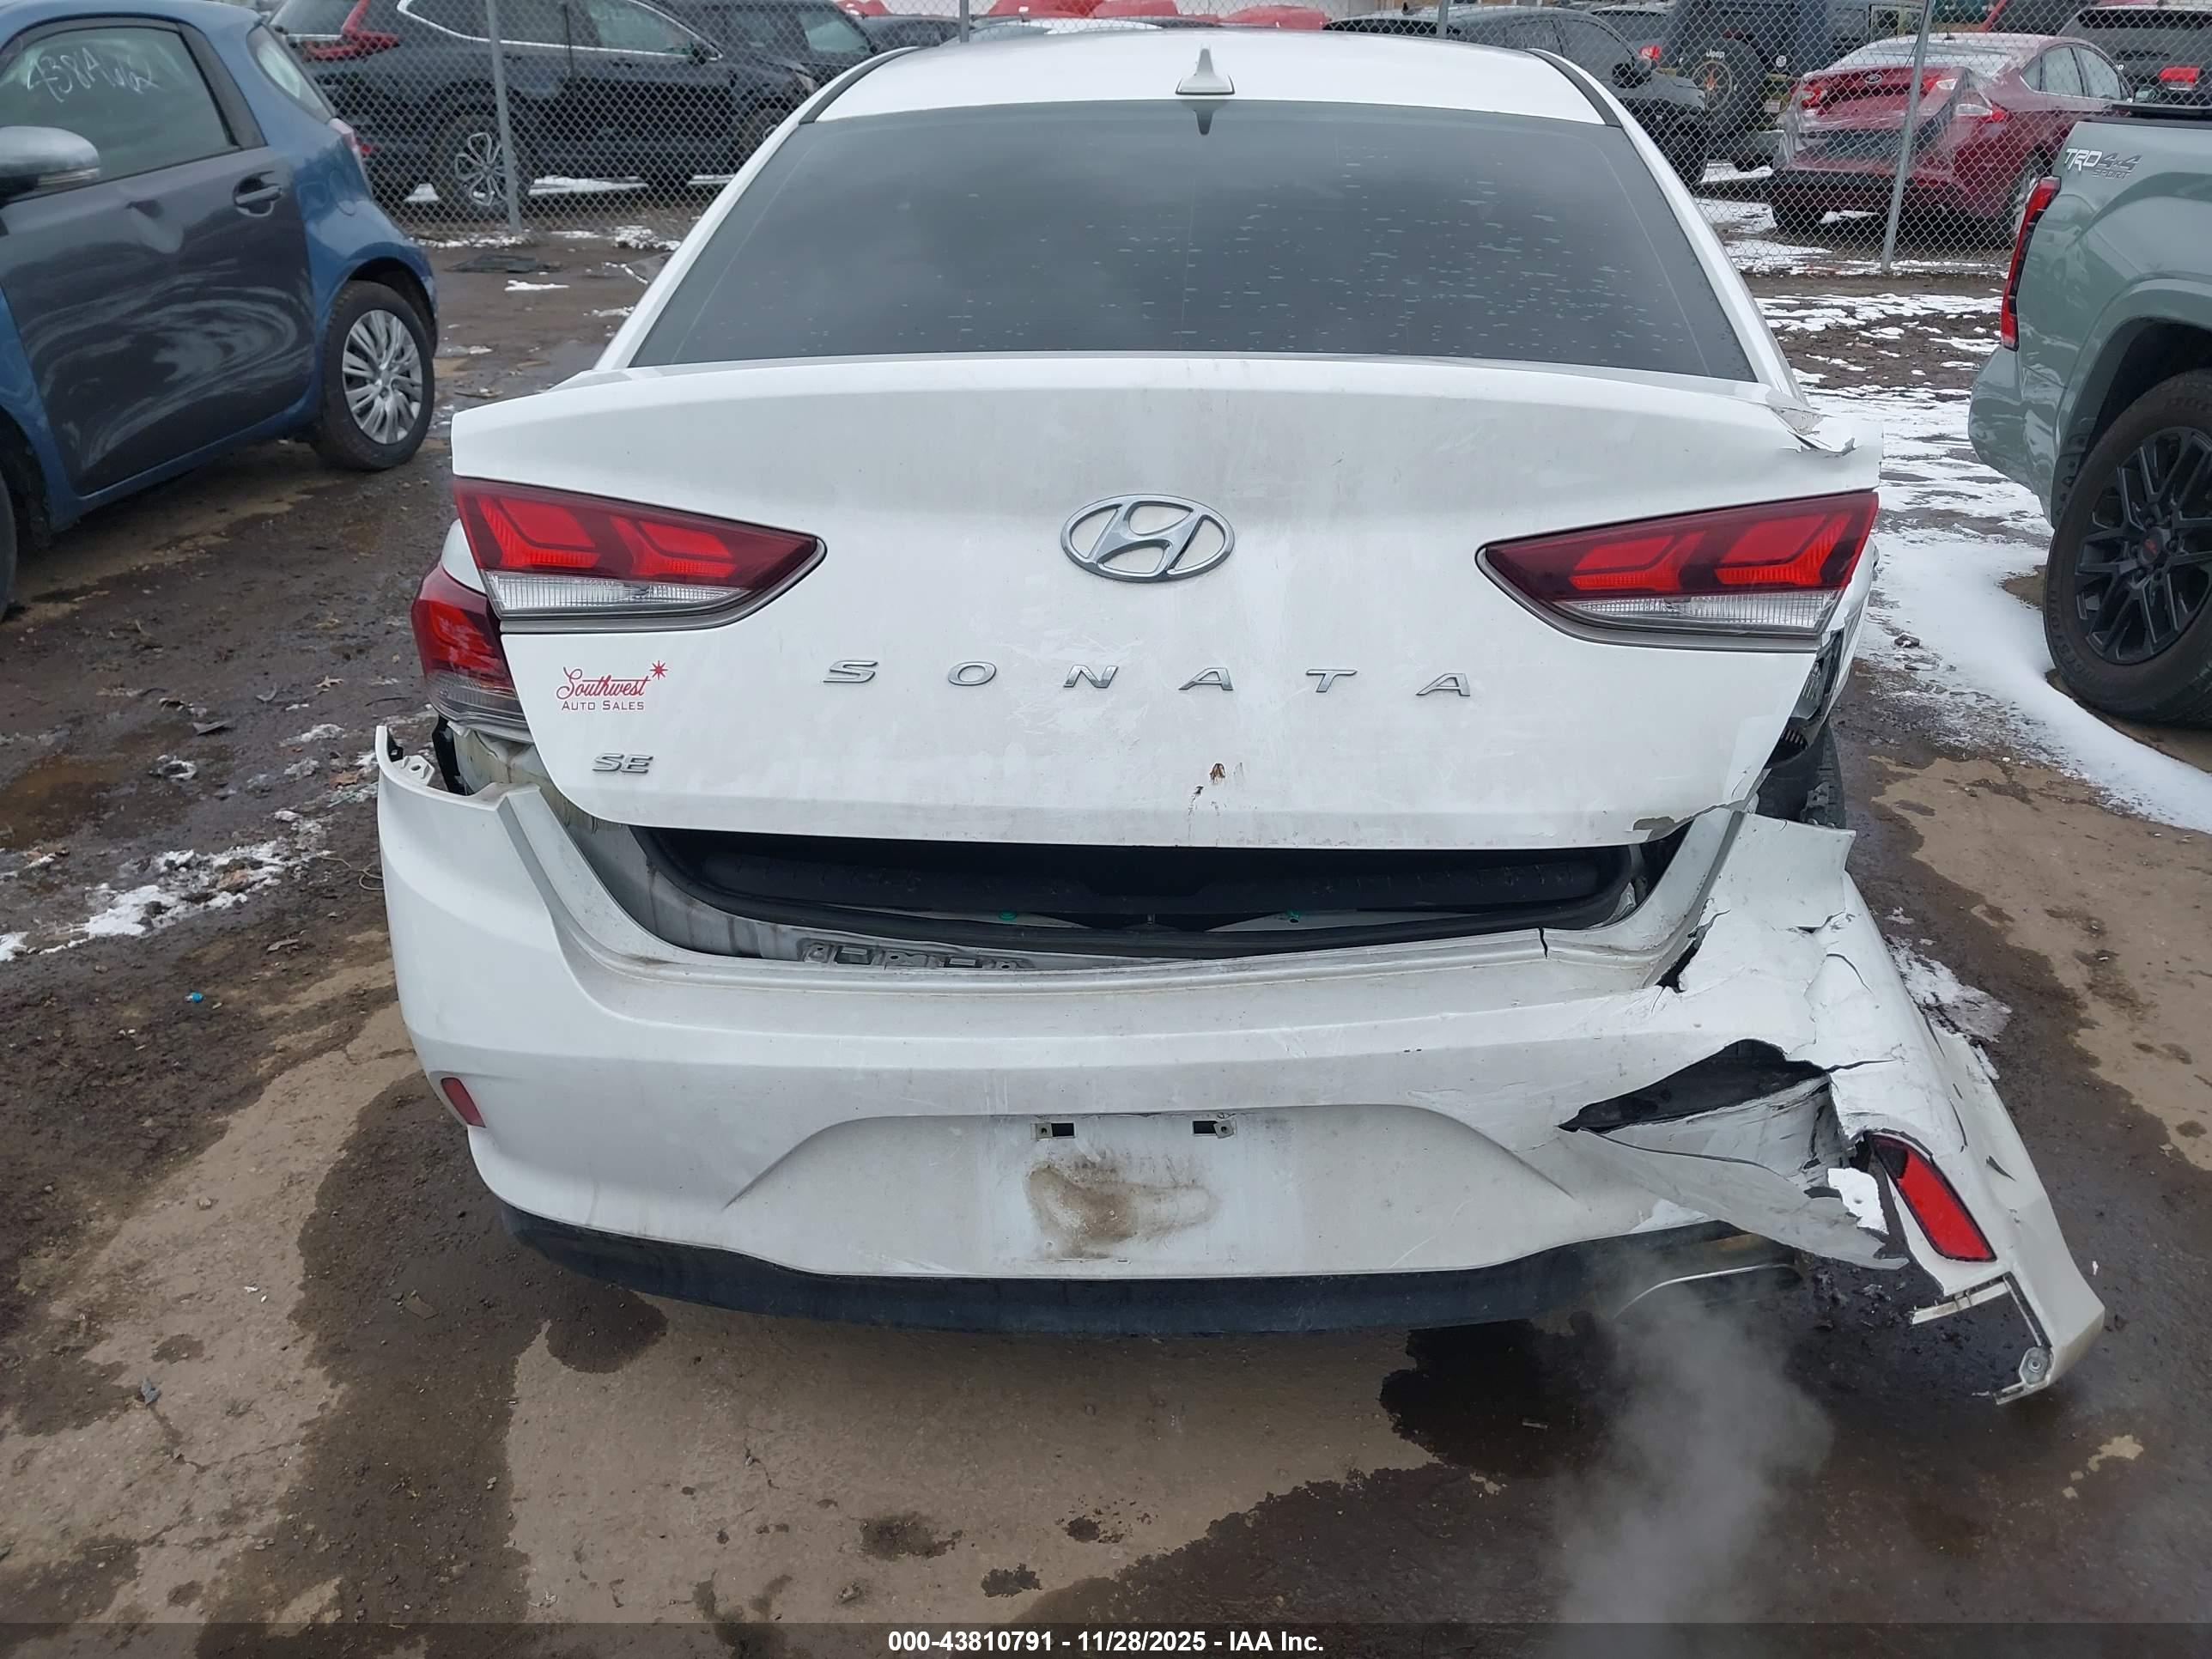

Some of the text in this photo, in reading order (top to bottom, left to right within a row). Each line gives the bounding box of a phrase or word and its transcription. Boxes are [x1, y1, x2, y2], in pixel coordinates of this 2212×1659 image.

[1705, 48, 1726, 59] Jeep
[2064, 148, 2103, 172] TRD
[556, 665, 651, 700] Southwest
[823, 659, 1471, 697] SONATA
[561, 700, 645, 711] AUTO SALES
[592, 752, 654, 775] SE
